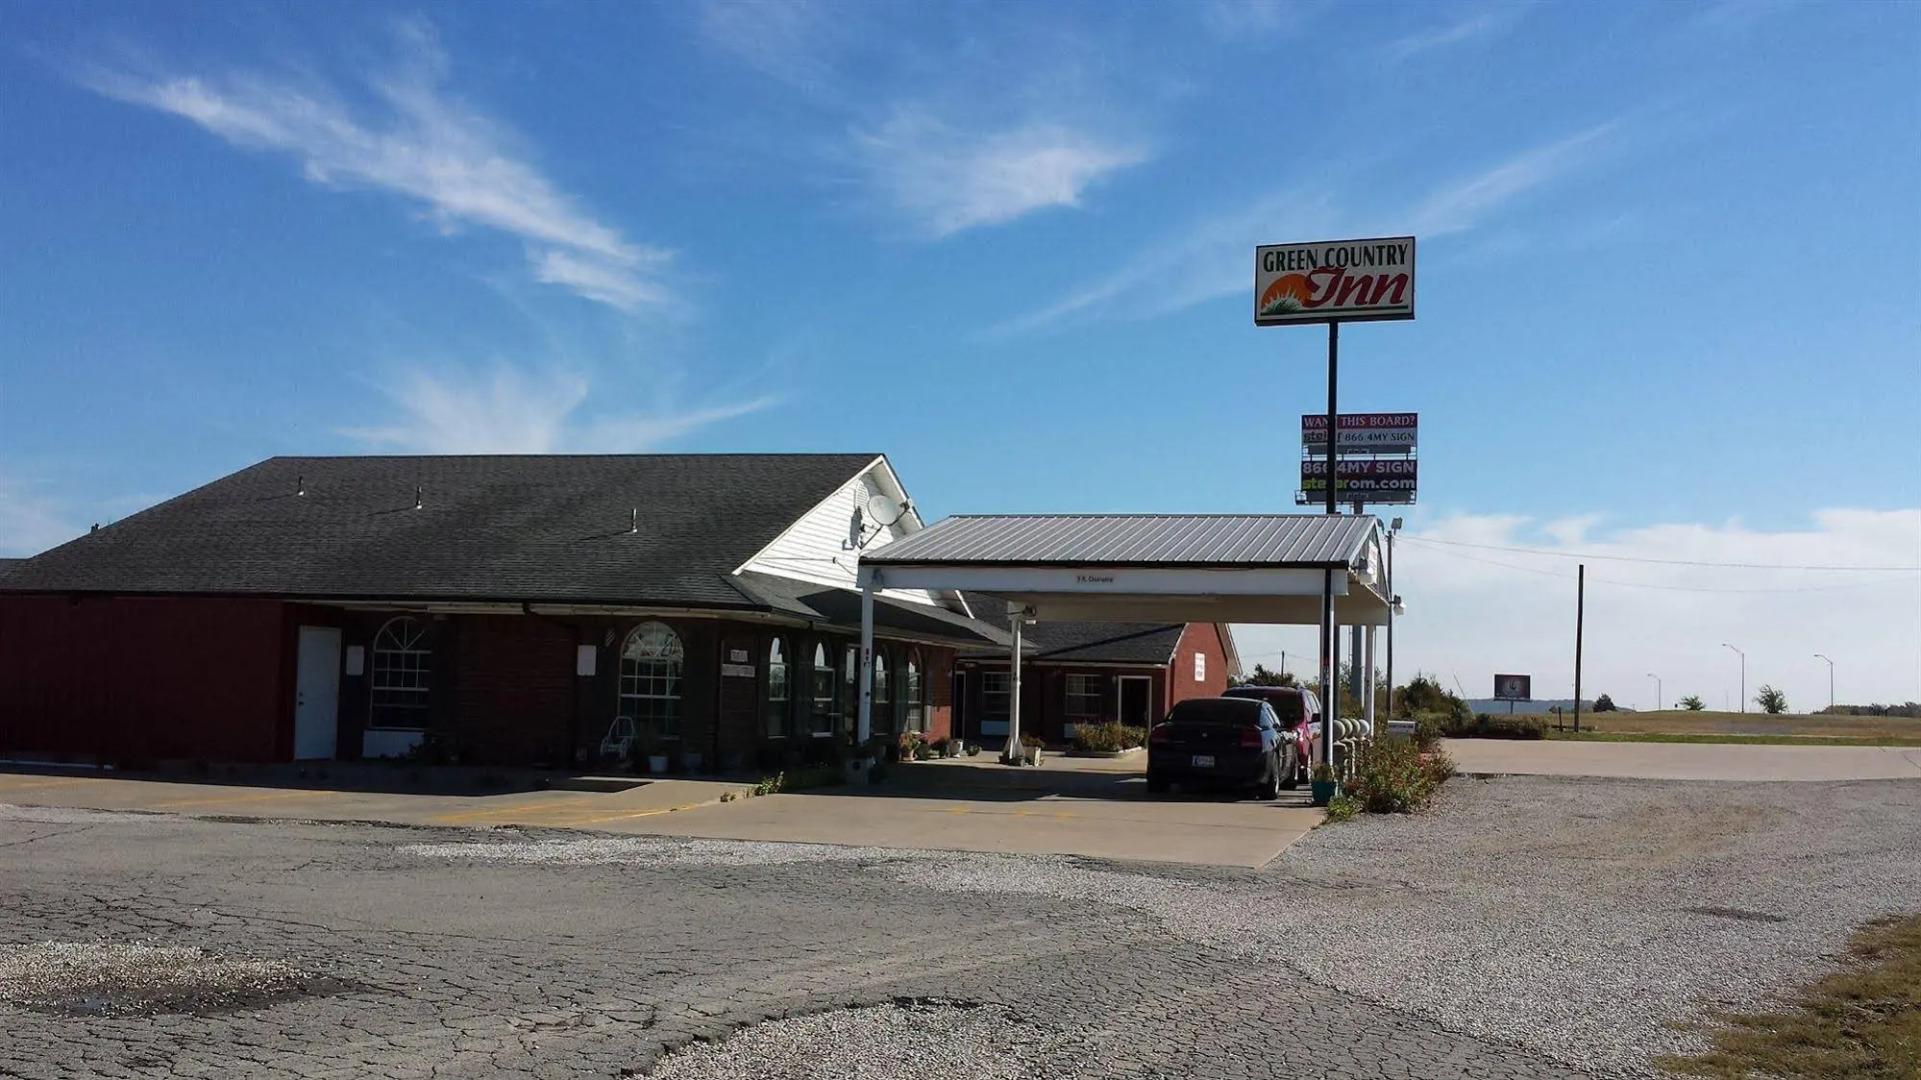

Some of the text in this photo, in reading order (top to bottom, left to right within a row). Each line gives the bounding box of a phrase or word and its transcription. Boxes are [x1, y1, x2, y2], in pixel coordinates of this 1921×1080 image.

[1263, 244, 1408, 272] GREEN COUNTRY
[1303, 265, 1409, 308] Inn
[1304, 416, 1415, 427] WAN THIS BOARD?
[1344, 432, 1415, 441] 866 4MY SIGN
[1336, 462, 1371, 473] 4MY
[1375, 462, 1415, 473] SIGN
